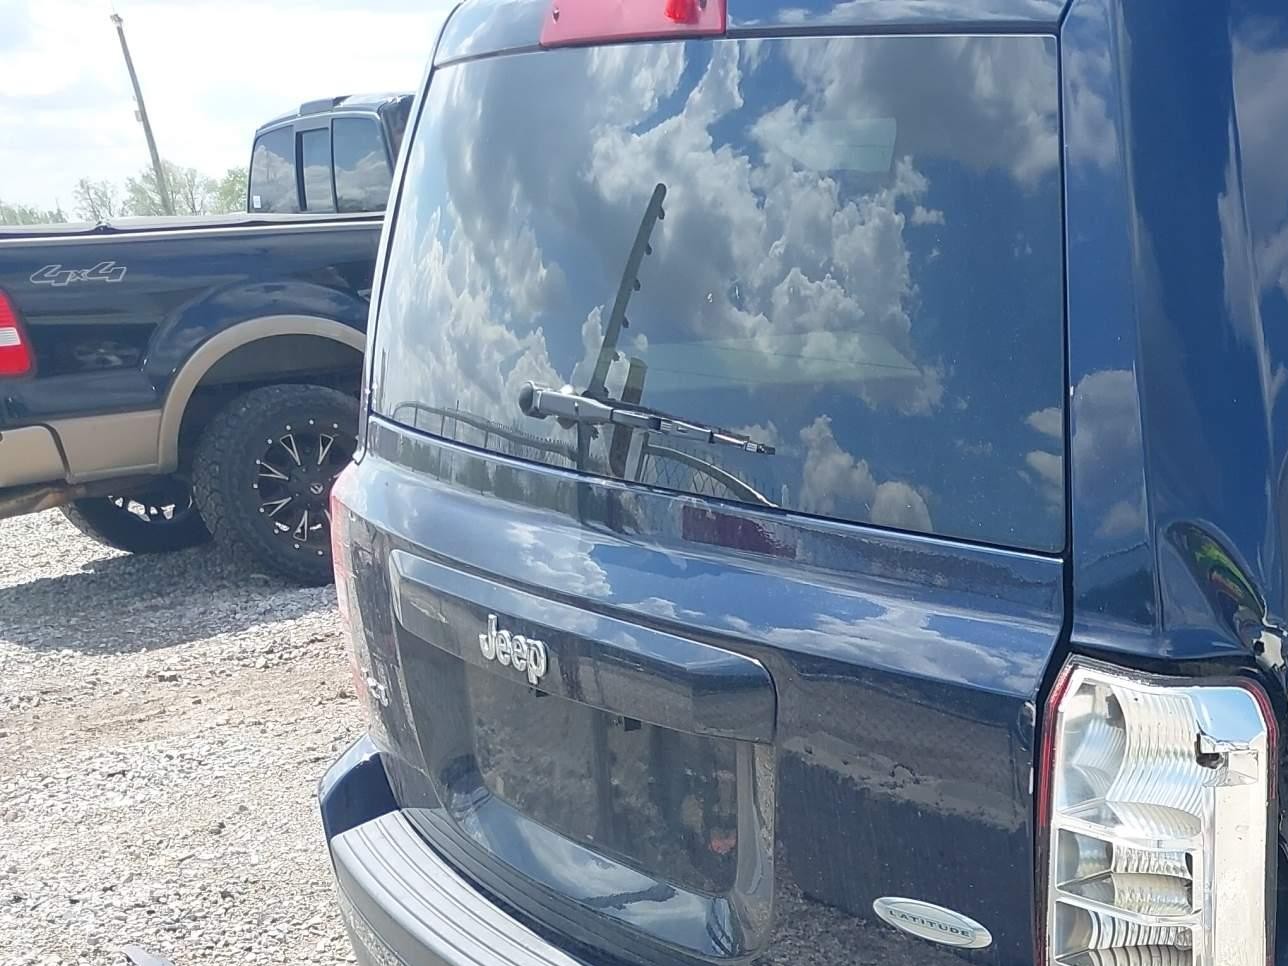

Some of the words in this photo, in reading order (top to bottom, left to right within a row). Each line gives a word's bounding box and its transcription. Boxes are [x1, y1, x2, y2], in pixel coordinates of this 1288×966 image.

[29, 261, 127, 286] 4x4
[479, 613, 547, 685] Jeep
[889, 909, 971, 938] LATITUDE
